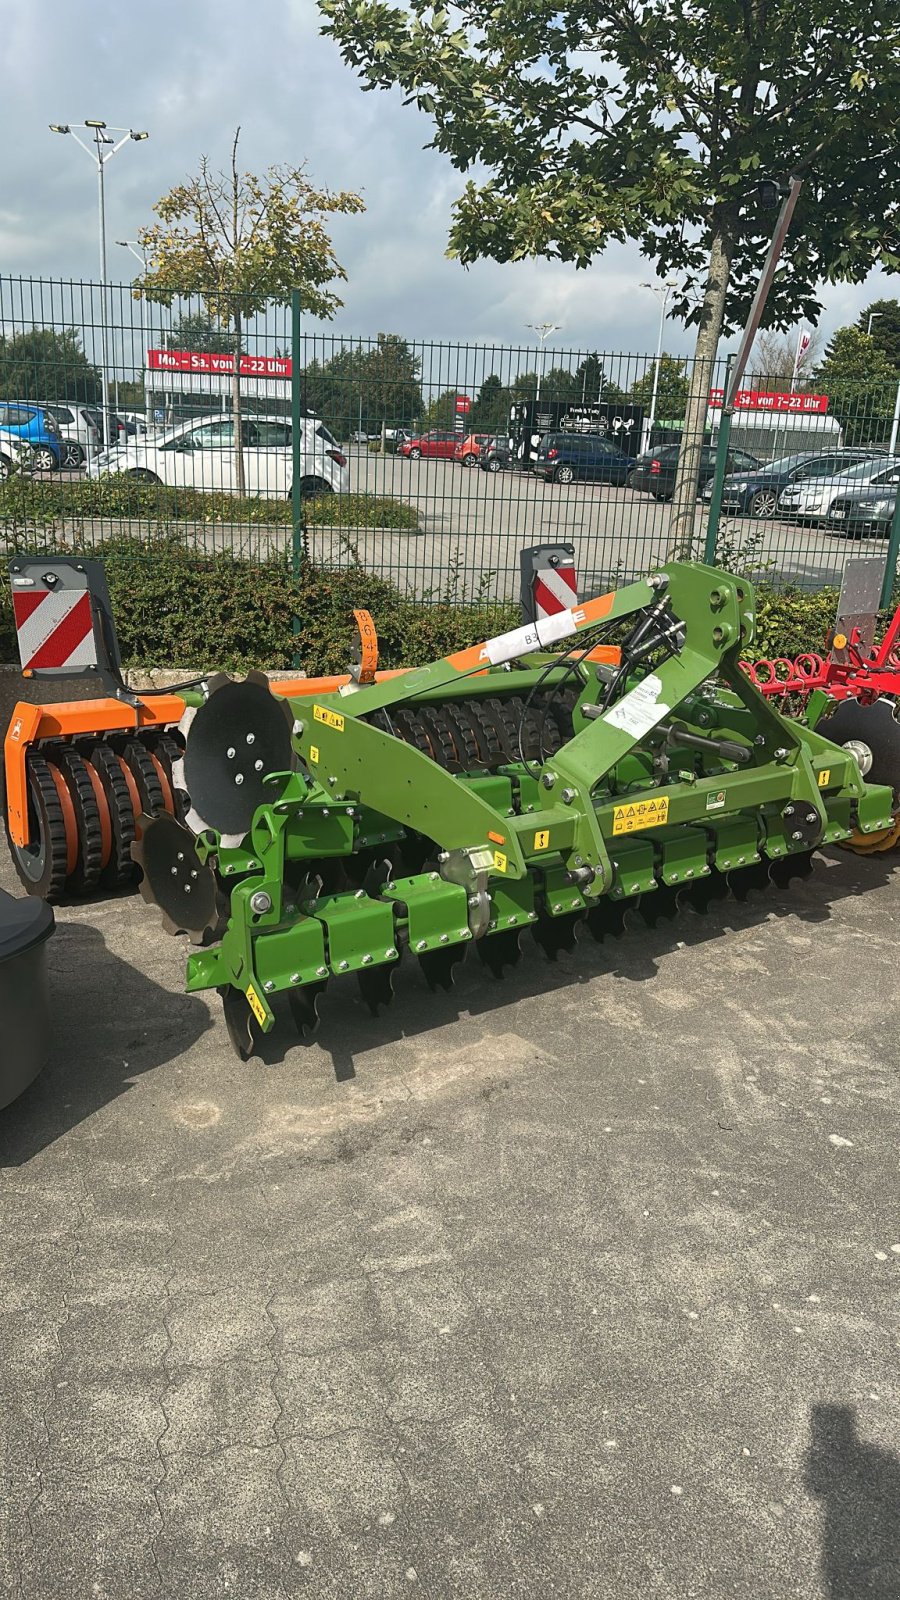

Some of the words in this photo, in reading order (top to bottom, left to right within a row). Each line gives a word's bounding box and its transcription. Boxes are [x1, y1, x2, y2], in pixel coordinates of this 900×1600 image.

[158, 353, 179, 366] Mo.
[191, 355, 209, 368] Sa.
[212, 359, 233, 369] von
[267, 361, 287, 373] Uhr
[757, 396, 774, 406] von
[804, 397, 820, 409] Uhr
[363, 624, 372, 636] 6
[366, 640, 374, 652] 4
